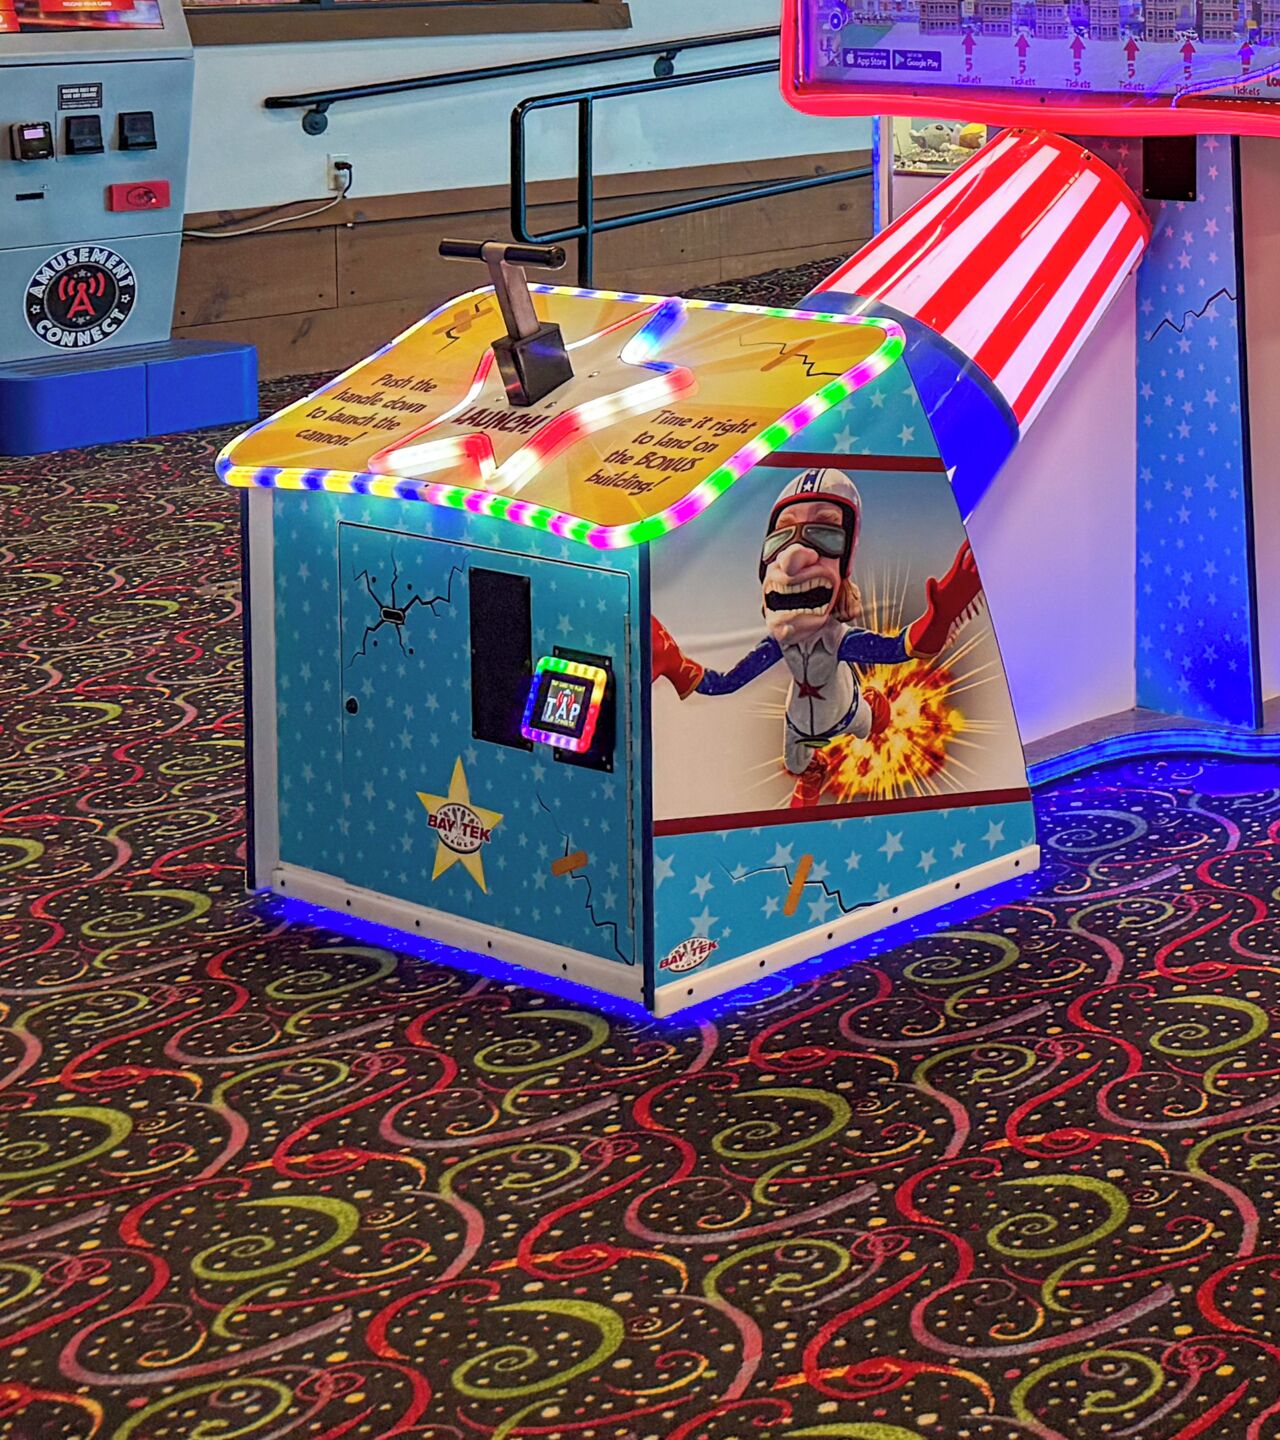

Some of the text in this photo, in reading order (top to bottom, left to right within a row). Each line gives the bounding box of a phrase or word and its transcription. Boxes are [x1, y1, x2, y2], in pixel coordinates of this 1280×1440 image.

[966, 60, 973, 72] 5
[1019, 61, 1027, 74] 5
[1073, 62, 1081, 76] 5
[1127, 64, 1135, 78] 5
[1183, 66, 1192, 80] 5
[957, 74, 982, 85] Tickets
[1010, 76, 1036, 86] Tickets
[1065, 79, 1091, 89] Tickets
[1119, 81, 1145, 91] Tickets
[1233, 86, 1260, 96] Tickets
[29, 247, 135, 300] AMUSEMENT
[36, 307, 127, 348] CONNECT
[372, 373, 438, 393] Push the
[331, 387, 428, 414] handle down
[306, 406, 402, 431] to launch the
[451, 406, 549, 435] LAUNCH!
[651, 409, 757, 437] Time it right
[296, 429, 368, 447] cannon!
[632, 431, 719, 453] to land on
[603, 449, 704, 473] the BONUS
[584, 468, 671, 497] building!
[545, 696, 581, 722] TAP
[428, 814, 491, 842] BAY TEK
[659, 951, 686, 969] BAY
